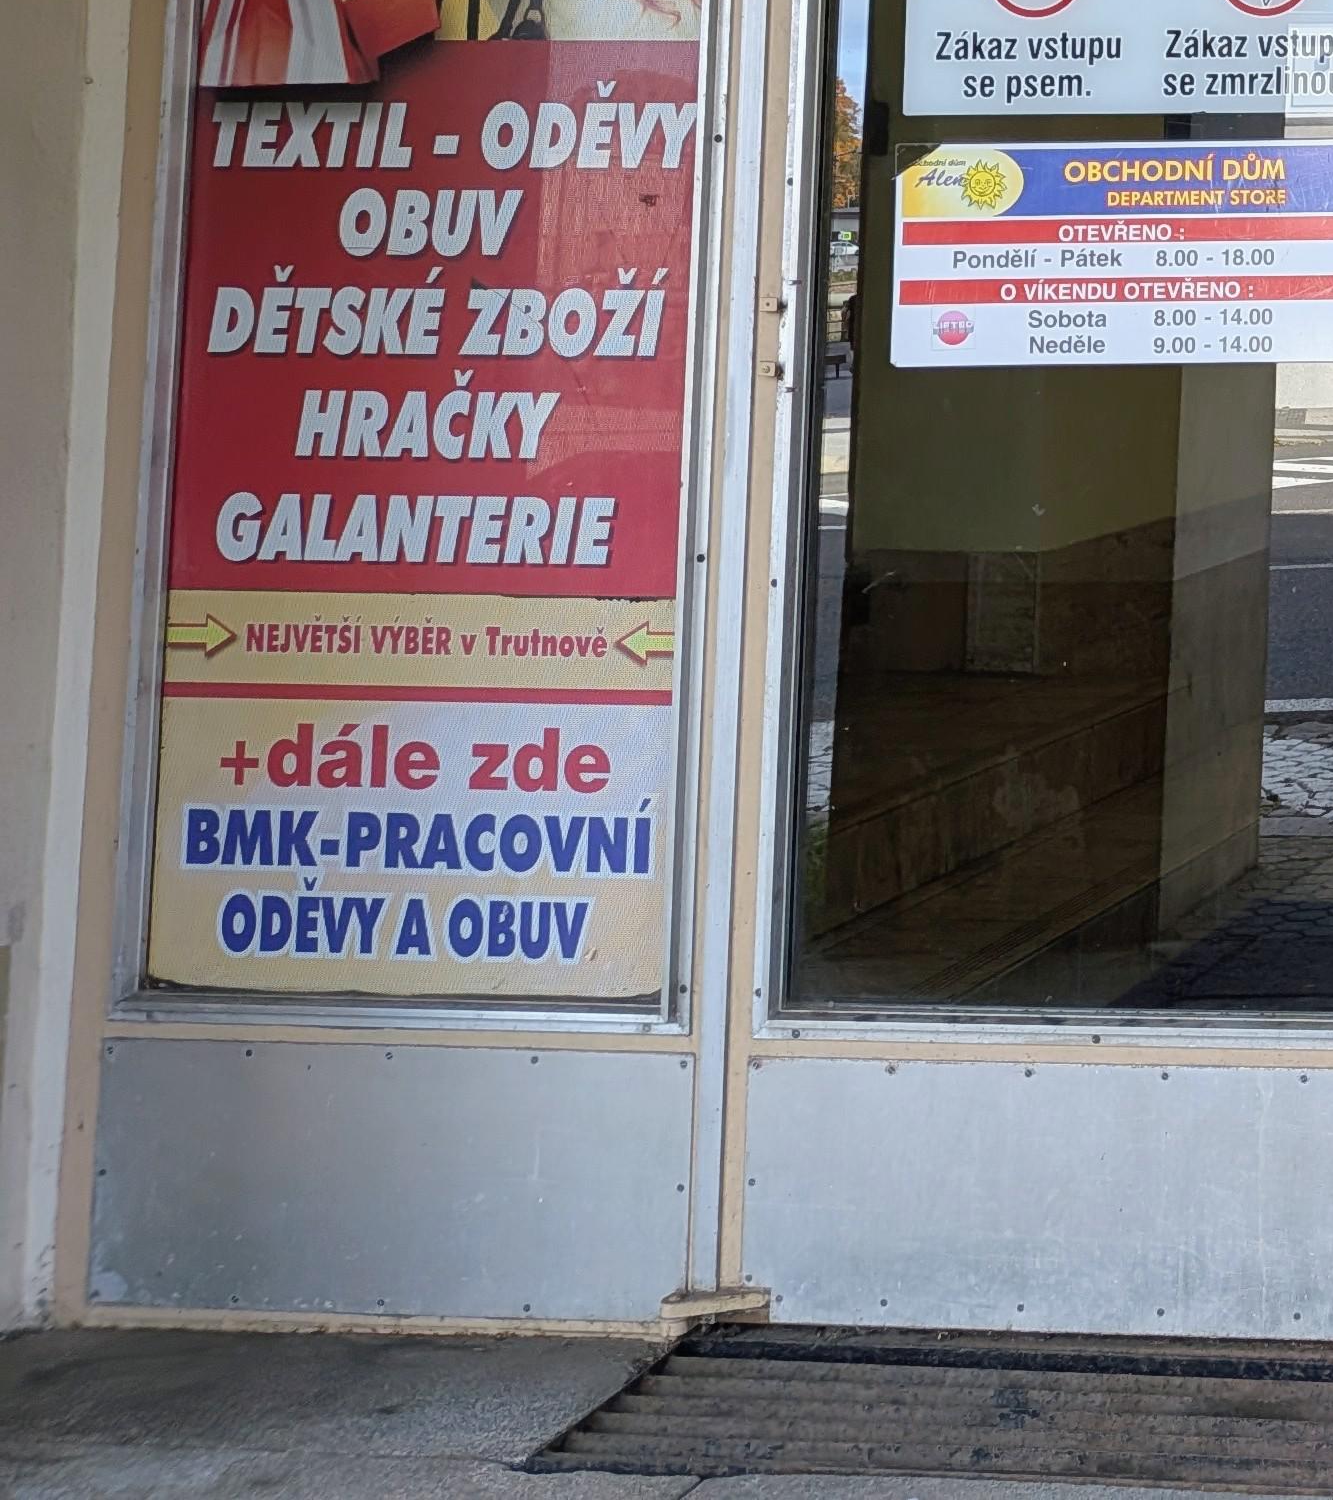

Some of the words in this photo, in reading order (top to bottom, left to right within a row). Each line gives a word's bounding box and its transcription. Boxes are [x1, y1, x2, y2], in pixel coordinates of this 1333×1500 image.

[935, 31, 1017, 61] Zákaz
[1028, 33, 1122, 65] vstupu
[1165, 29, 1248, 59] Zákaz
[963, 74, 995, 98] se
[1006, 72, 1092, 103] psem.
[1163, 72, 1195, 96] se
[210, 100, 413, 169] TEXTIL
[480, 80, 698, 171] ODĚVY
[1064, 154, 1214, 183] OBCHODNÍ
[1222, 153, 1286, 182] DŮM
[1107, 190, 1224, 208] DEPARTMENT
[1229, 188, 1287, 206] STORE
[338, 187, 524, 257] OBUV
[1058, 221, 1173, 242] OTEVŘENO
[952, 250, 1037, 269] Pondělí
[1060, 249, 1123, 268] Pátek
[1155, 250, 1199, 267] 8.00
[1221, 249, 1275, 266] 18.00
[1000, 284, 1017, 300] O
[1024, 279, 1118, 300] VÍKENDU
[1123, 279, 1240, 299] OTEVŘENO
[207, 264, 446, 356] DĚTSKÉ
[459, 267, 669, 358] ZBOŽÍ
[1028, 310, 1107, 329] Sobota
[1153, 310, 1196, 326] 8.00
[1219, 308, 1273, 325] 14.00
[1029, 336, 1107, 354] Neděle
[1153, 338, 1196, 354] 9.00
[1219, 336, 1273, 353] 14.00
[294, 369, 561, 460] HRAČKY
[215, 491, 616, 565] GALANTERIE
[245, 614, 364, 655] NEJVĚTŠÍ
[371, 617, 452, 657] VÝBĚR
[460, 635, 475, 656] v
[486, 627, 609, 659] Trutnově
[219, 723, 442, 791] +dále
[468, 727, 612, 794] zde
[183, 798, 654, 876] BMK-PRACOVNÍ
[220, 876, 385, 956] ODĚVY
[393, 898, 433, 958] A
[448, 898, 590, 960] OBUV
